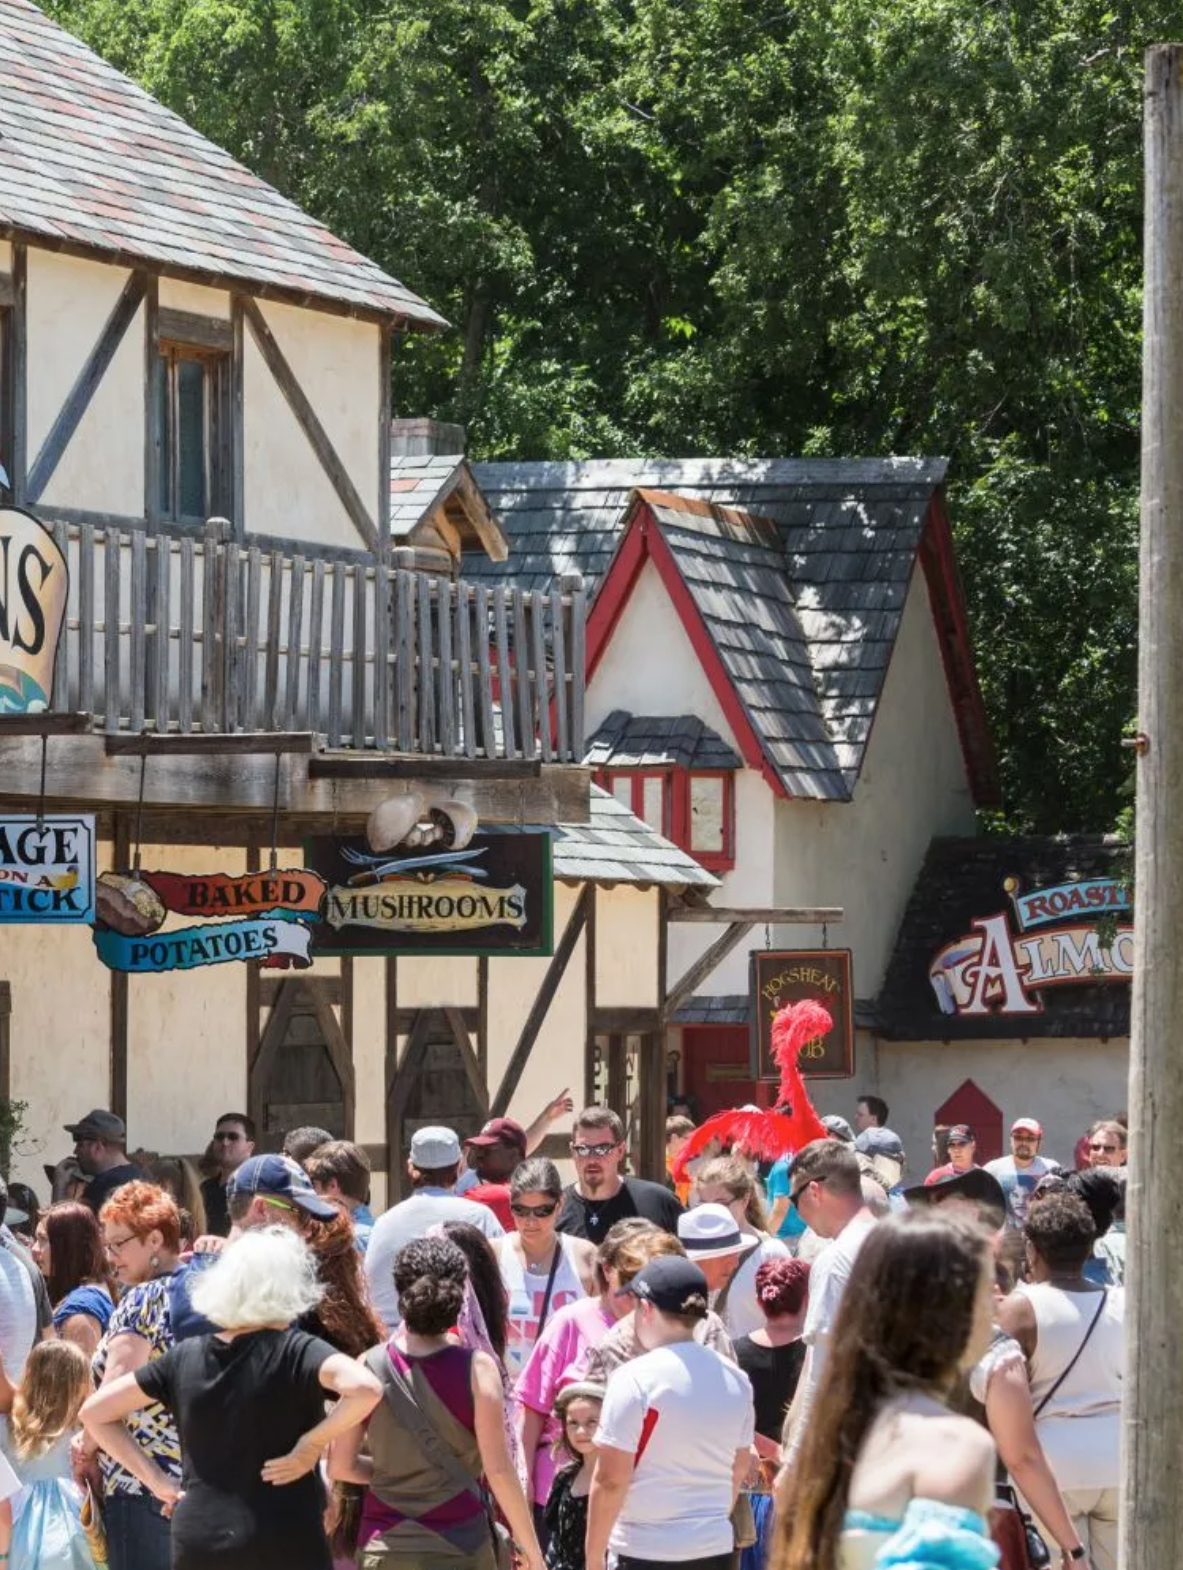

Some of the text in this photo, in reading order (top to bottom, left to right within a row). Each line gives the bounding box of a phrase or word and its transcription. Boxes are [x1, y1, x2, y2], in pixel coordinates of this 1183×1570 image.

[35, 875, 56, 887] A
[186, 879, 306, 909] BAKED
[330, 889, 524, 920] MUSHROOMS
[130, 926, 279, 966] POTATOES
[799, 1035, 825, 1058] UB
